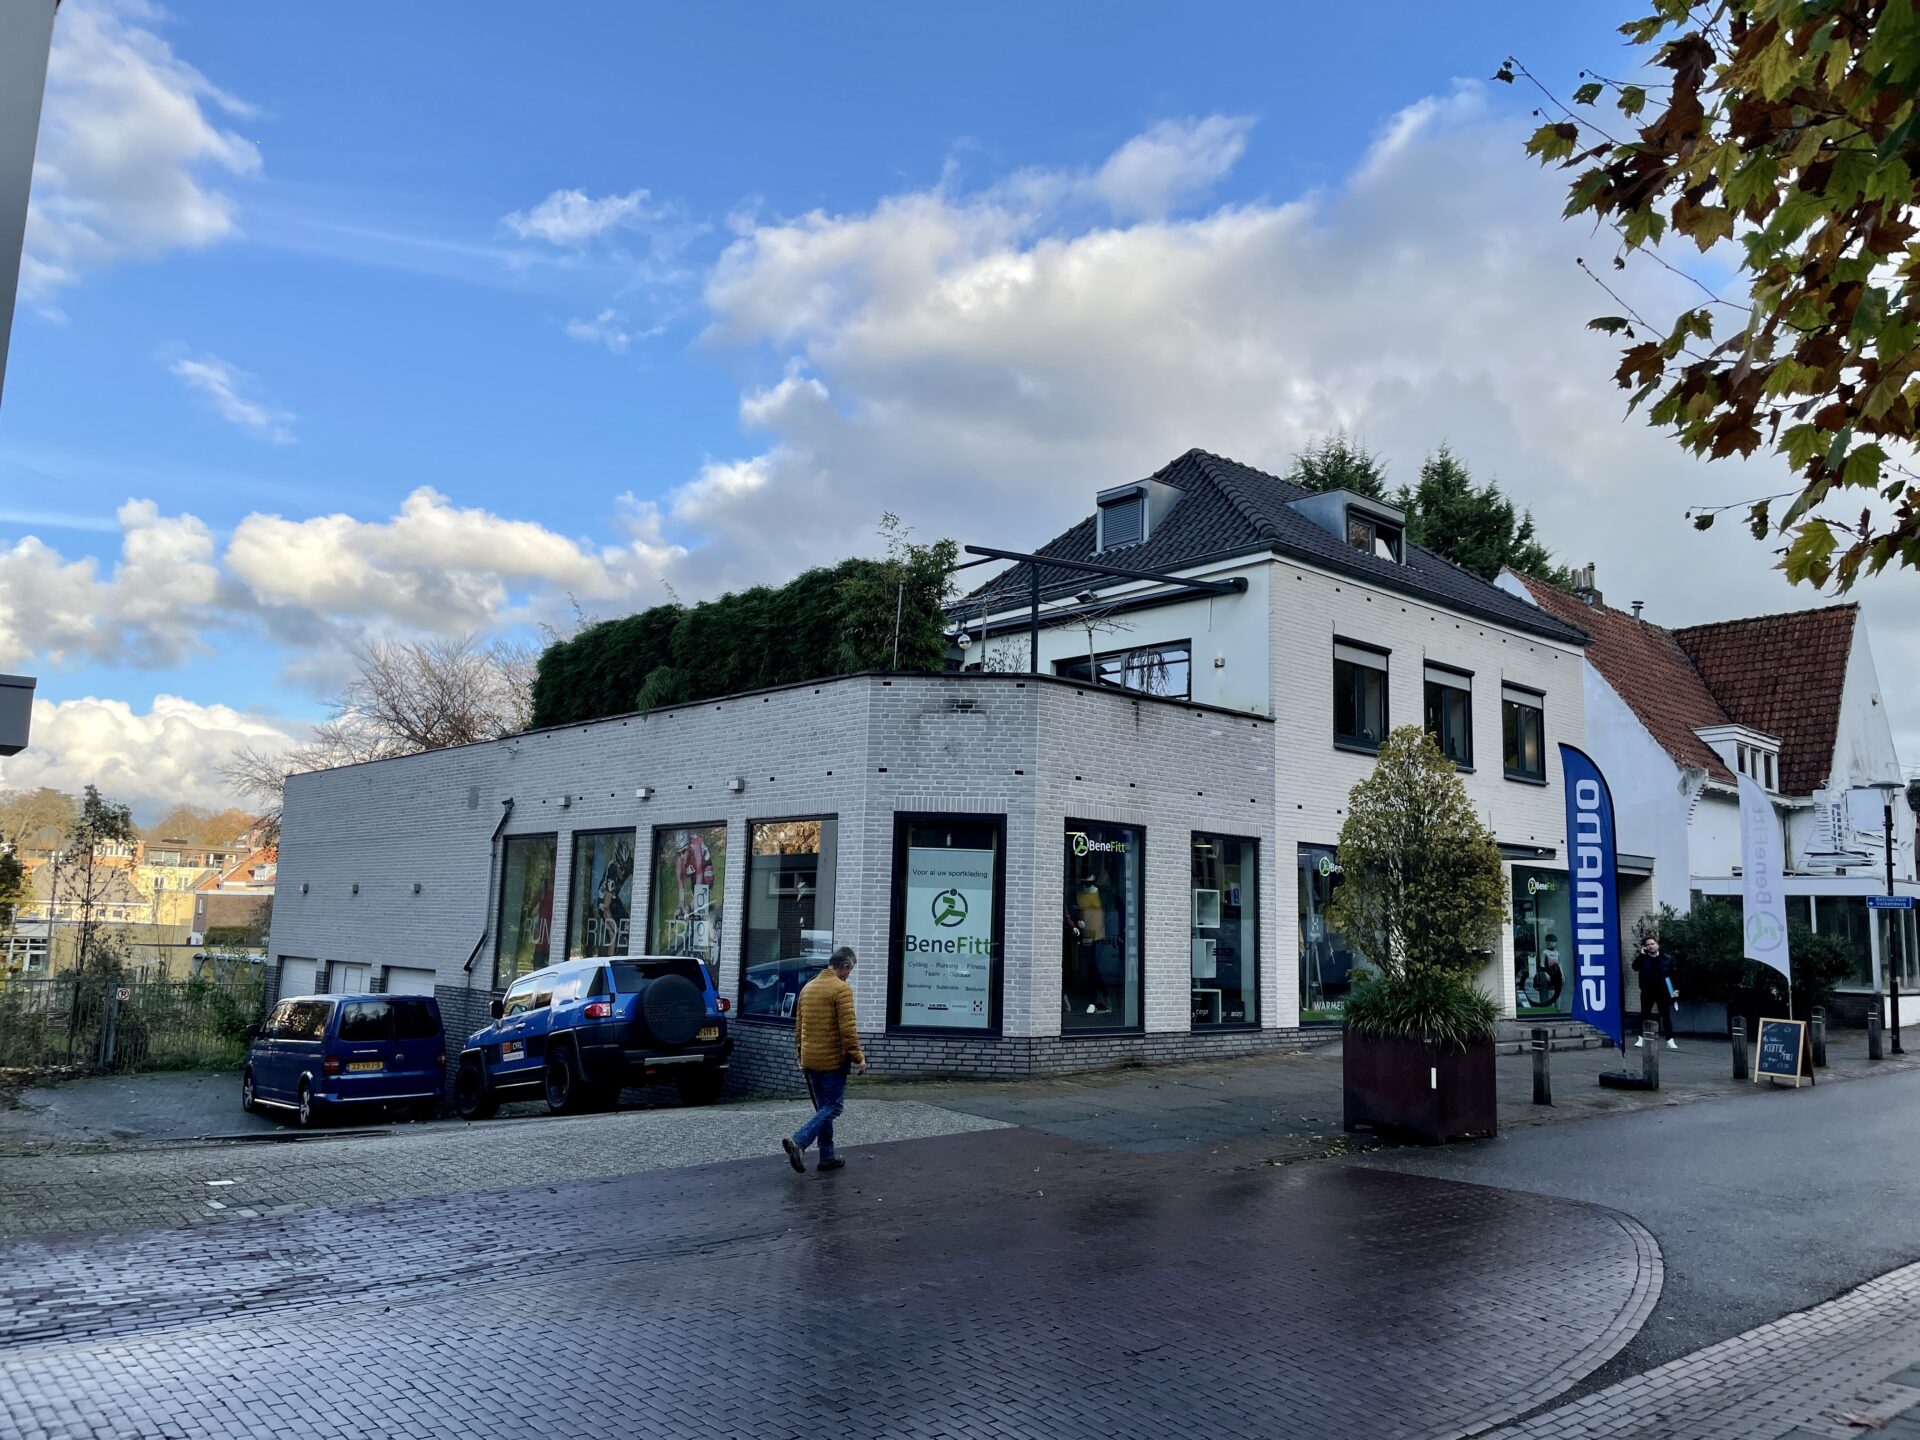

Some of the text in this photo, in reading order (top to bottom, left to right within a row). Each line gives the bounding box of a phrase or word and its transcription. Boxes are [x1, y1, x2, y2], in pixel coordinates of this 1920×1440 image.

[1089, 840, 1126, 853] BeneFitt
[948, 870, 988, 879] sportkleding
[586, 918, 631, 947] RIDE
[905, 934, 991, 955] BeneFitt
